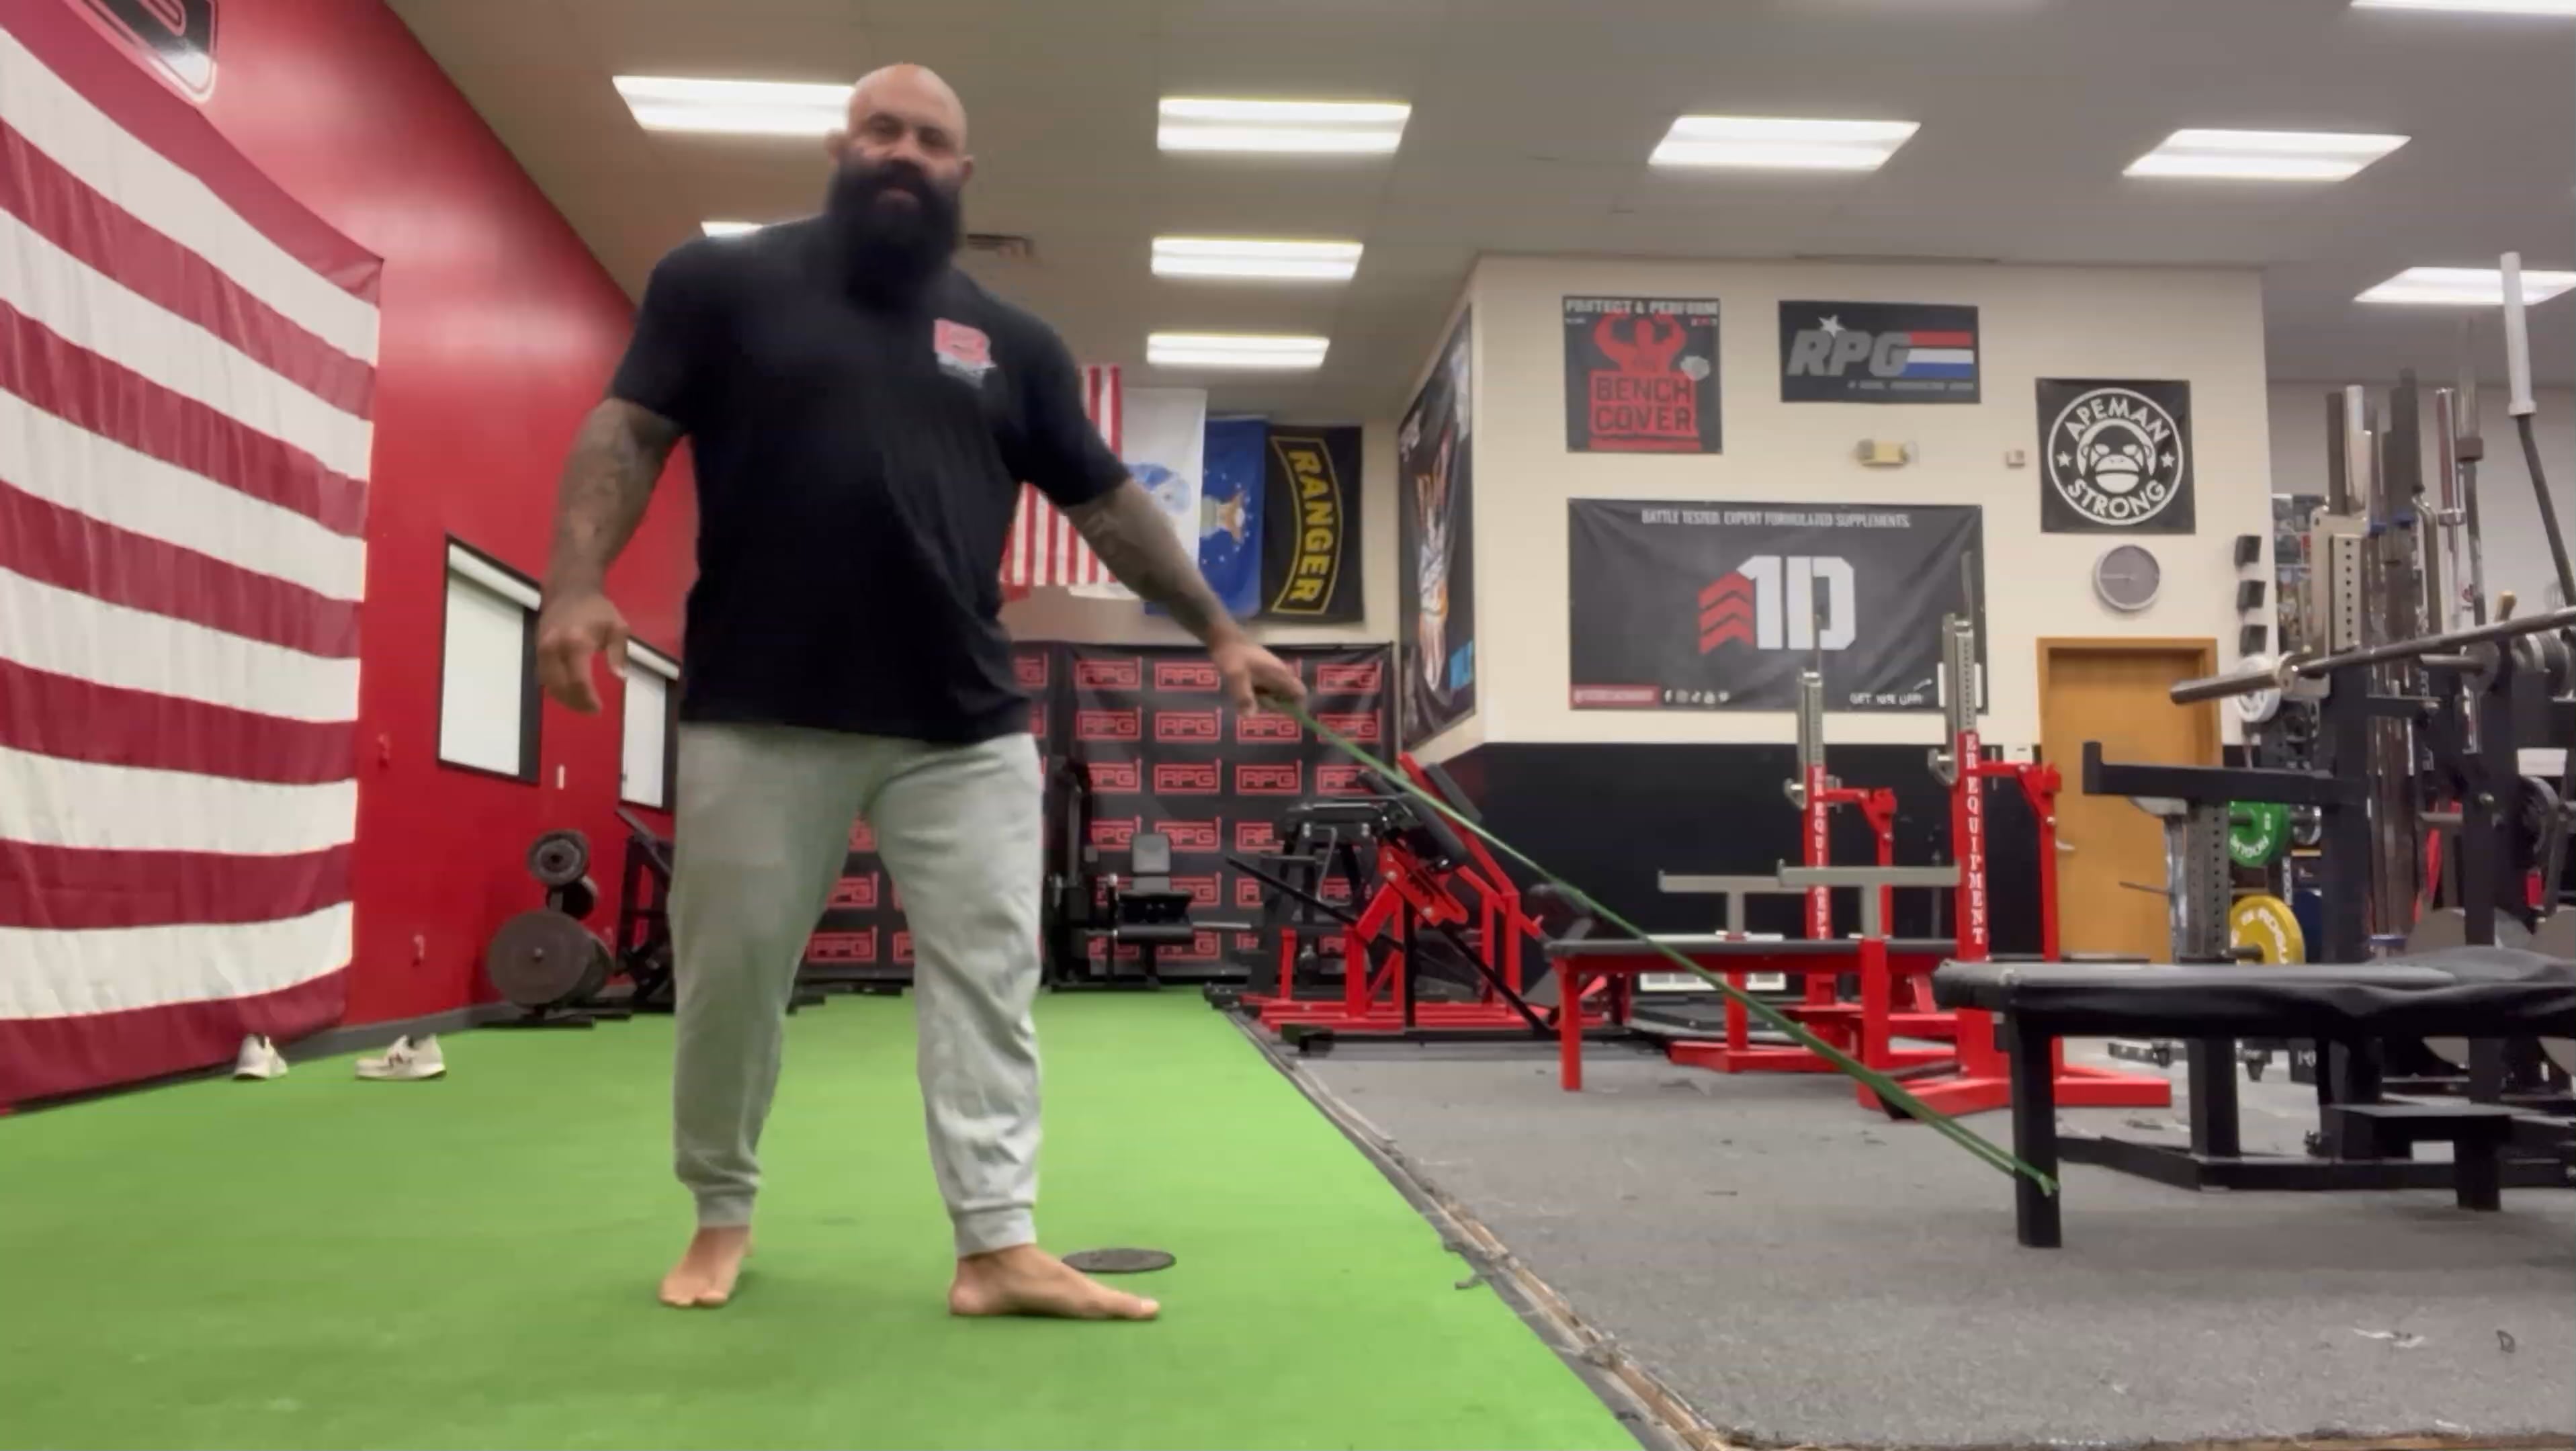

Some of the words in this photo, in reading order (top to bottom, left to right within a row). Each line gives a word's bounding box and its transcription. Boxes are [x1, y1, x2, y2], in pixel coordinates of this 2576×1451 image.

[1787, 329, 1910, 377] RPG
[1596, 377, 1692, 402] BENCH
[1595, 405, 1692, 431] COVER
[2064, 396, 2171, 443] APEMAN
[2067, 478, 2166, 519] STRONG
[1288, 450, 1334, 602] RANGER
[1641, 510, 1679, 525] BATTLE
[1160, 717, 1217, 736] RPG
[1242, 719, 1297, 737] RPG
[1160, 771, 1217, 788] RPG
[1242, 772, 1297, 790] RPG
[1967, 776, 1985, 944] EQUIPMENT
